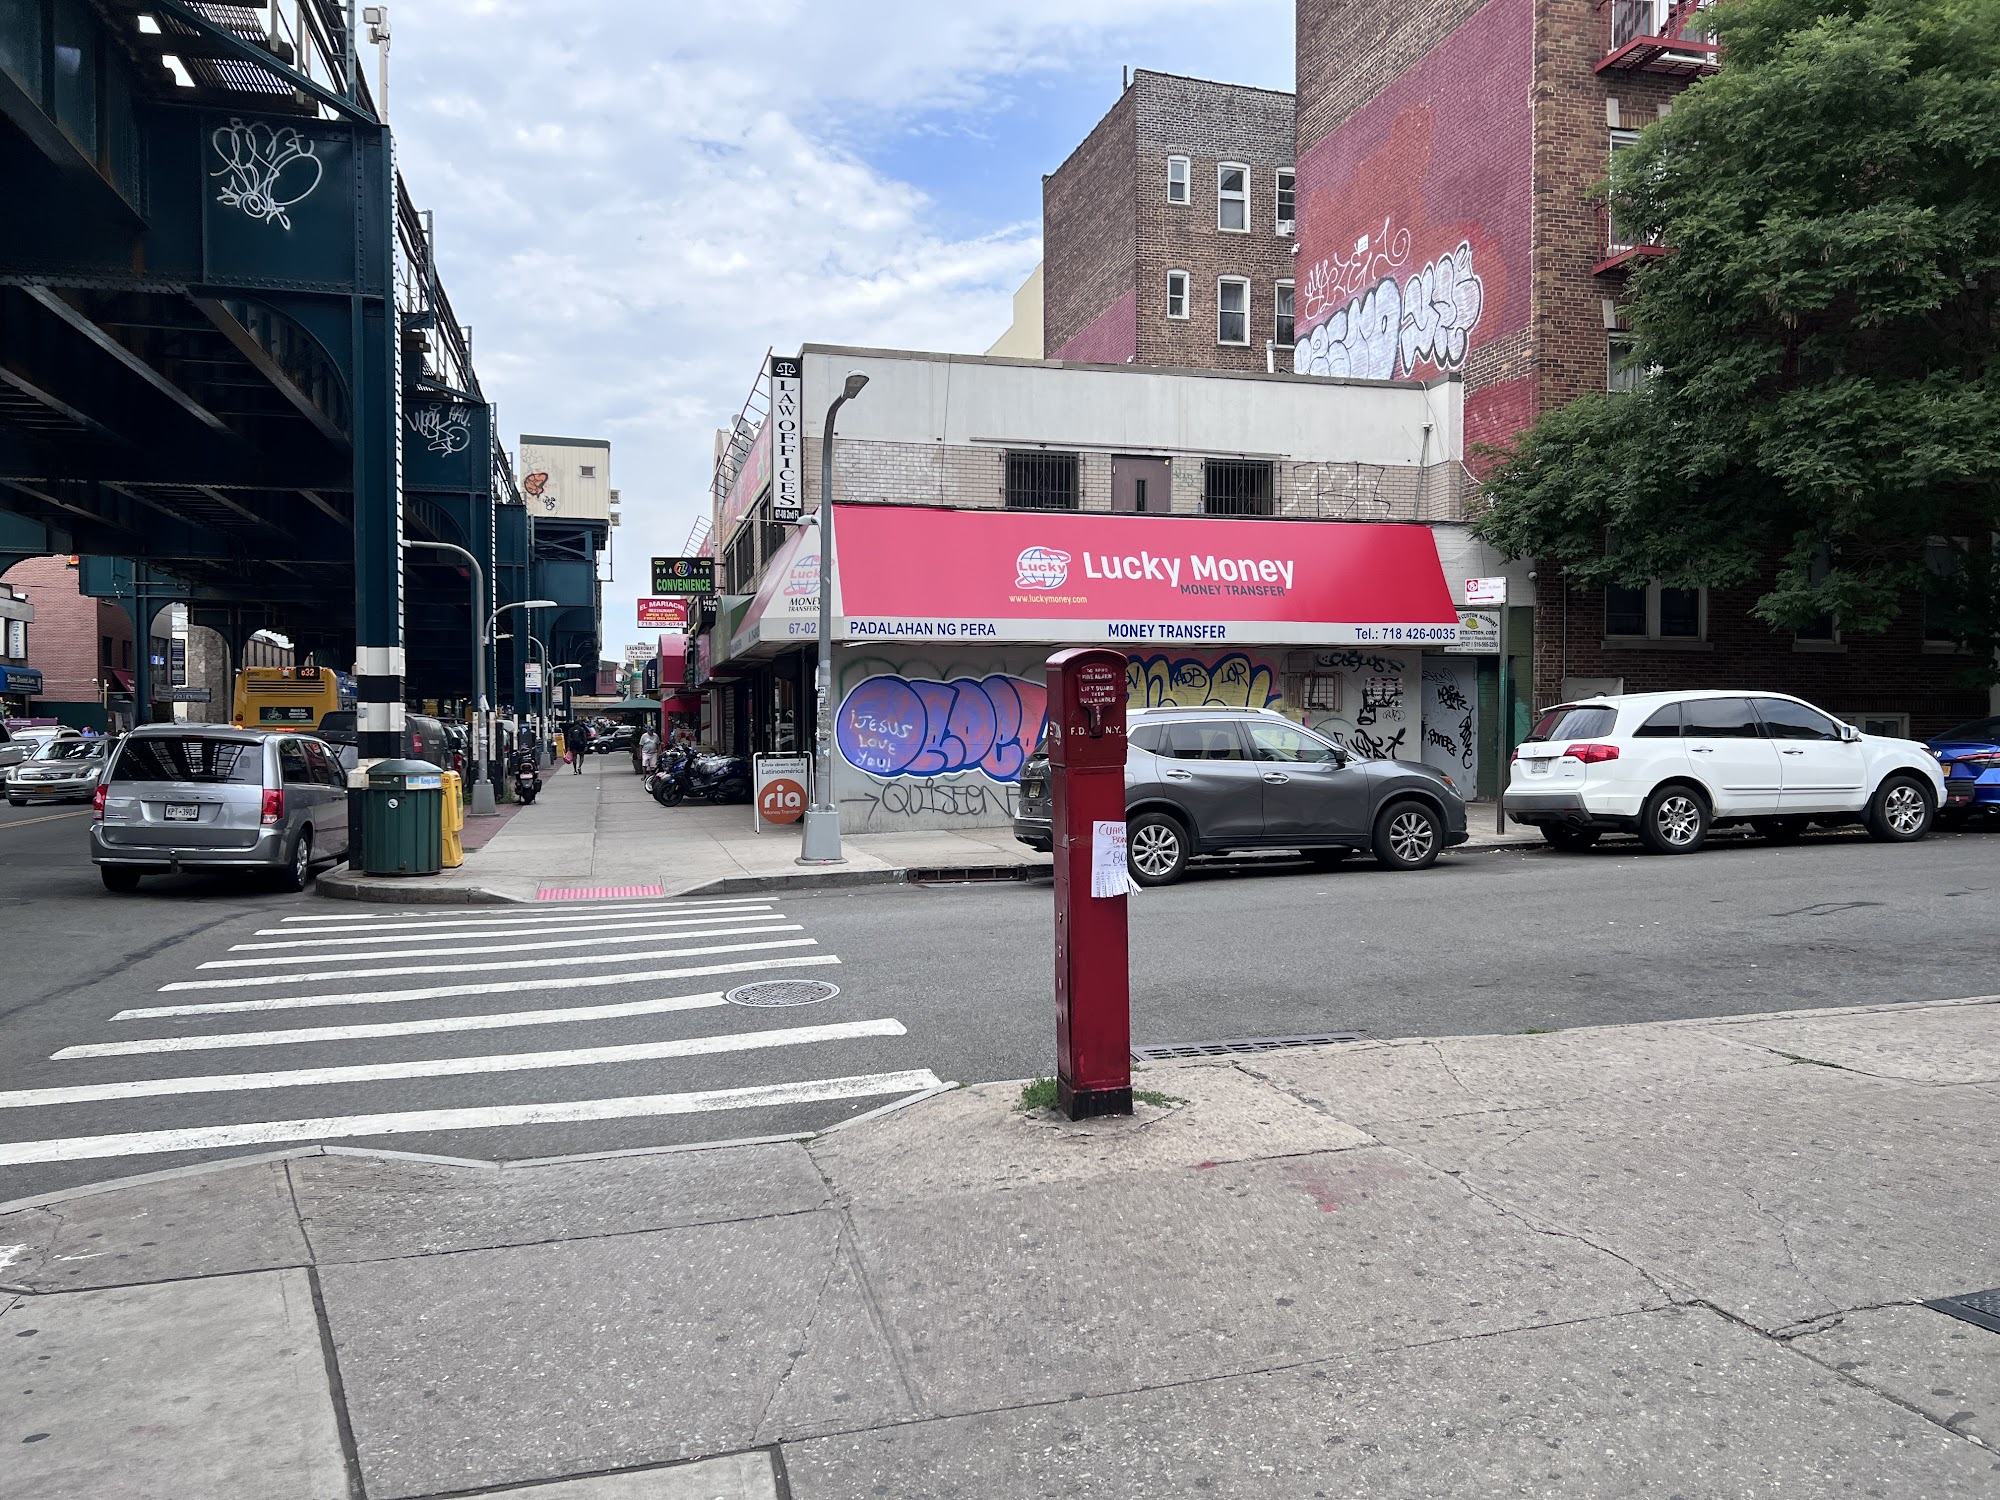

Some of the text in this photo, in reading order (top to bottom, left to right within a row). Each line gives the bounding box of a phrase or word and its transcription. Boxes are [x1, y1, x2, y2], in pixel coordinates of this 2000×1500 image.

[777, 380, 797, 506] LAW OFFICES
[789, 568, 821, 579] Luck
[1018, 561, 1066, 574] Lucky
[1082, 550, 1295, 589] Lucky Money
[656, 578, 711, 592] CONVENIENCE
[1180, 583, 1285, 597] MONEY TRANSFER
[639, 600, 685, 611] EL MARIACHI
[1008, 594, 1088, 605] www.luckymoney.com
[788, 622, 817, 634] 67-02
[850, 621, 996, 637] PADALAHAN NG PERA
[1108, 623, 1226, 639] MONEY TRANSFER
[1354, 627, 1456, 641] Tel.: 718 426-0035
[1070, 725, 1122, 736] F.D. N.Y.
[858, 734, 897, 755] LOVE
[764, 784, 801, 809] ria
[1098, 823, 1124, 836] CUAR
